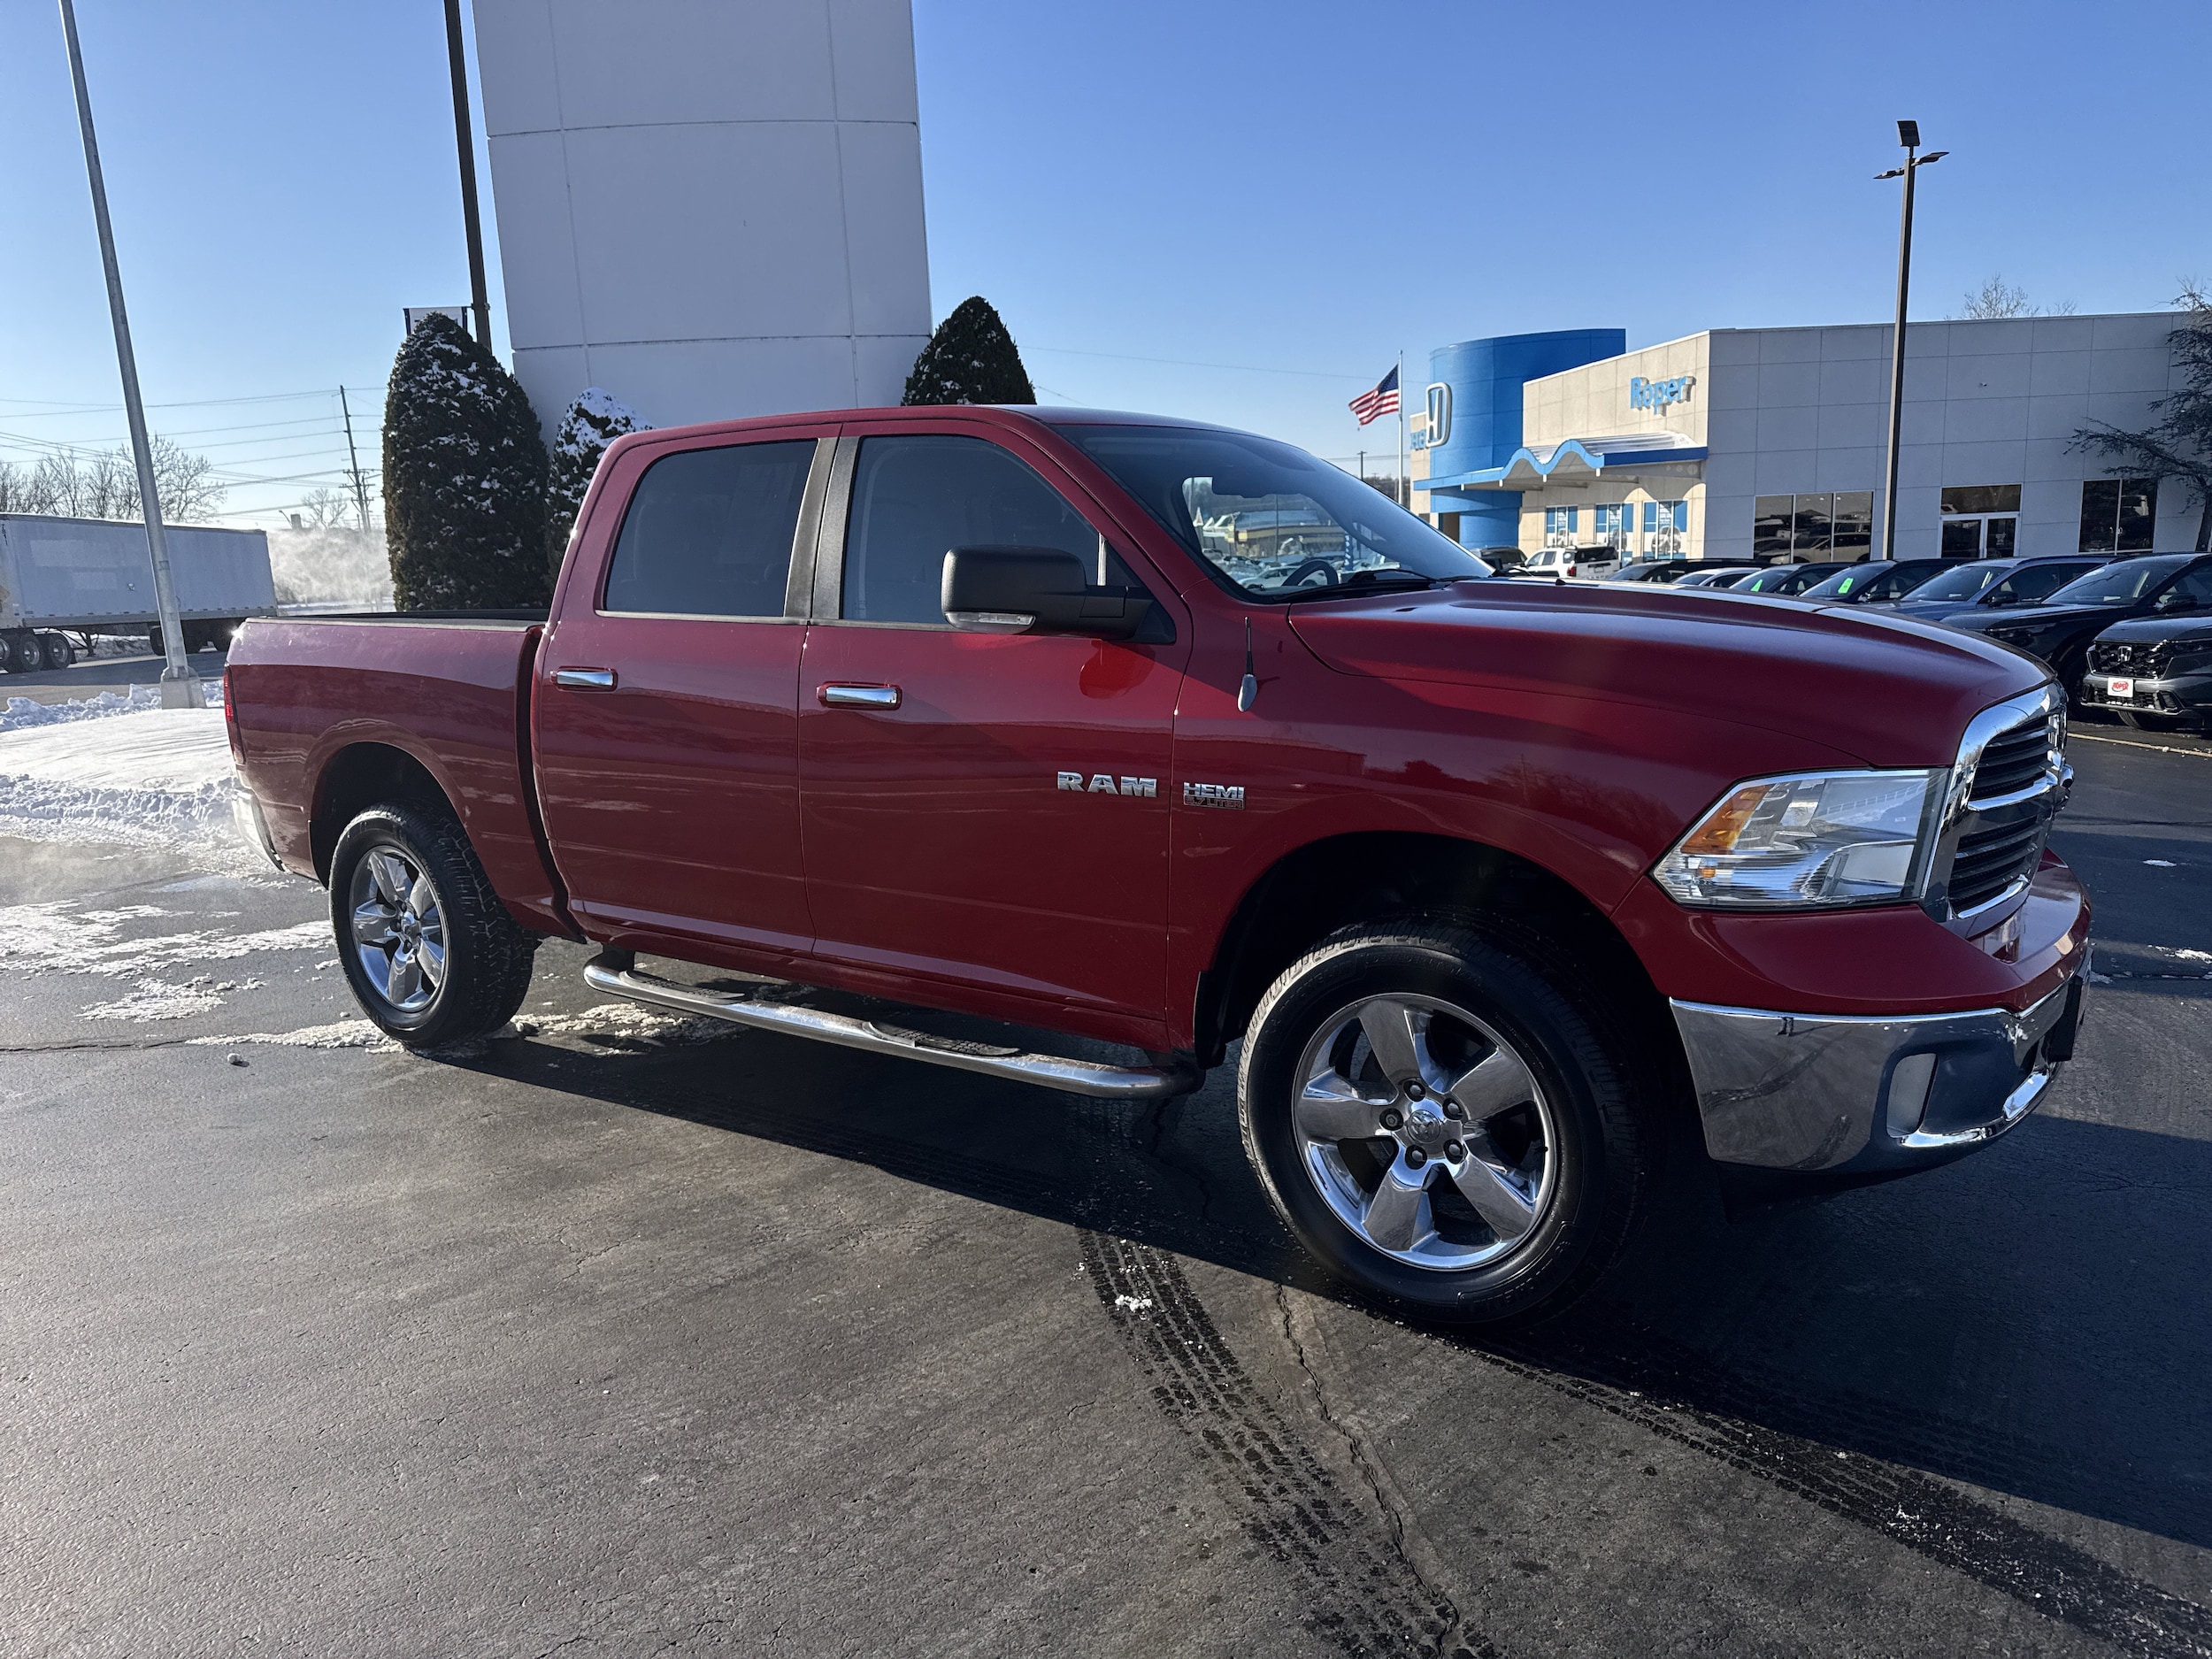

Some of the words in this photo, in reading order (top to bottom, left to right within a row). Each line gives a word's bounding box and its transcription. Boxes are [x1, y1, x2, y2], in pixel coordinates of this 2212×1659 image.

[1630, 375, 1694, 416] Roper
[1057, 771, 1157, 797] RAM
[1183, 781, 1245, 799] HEMI
